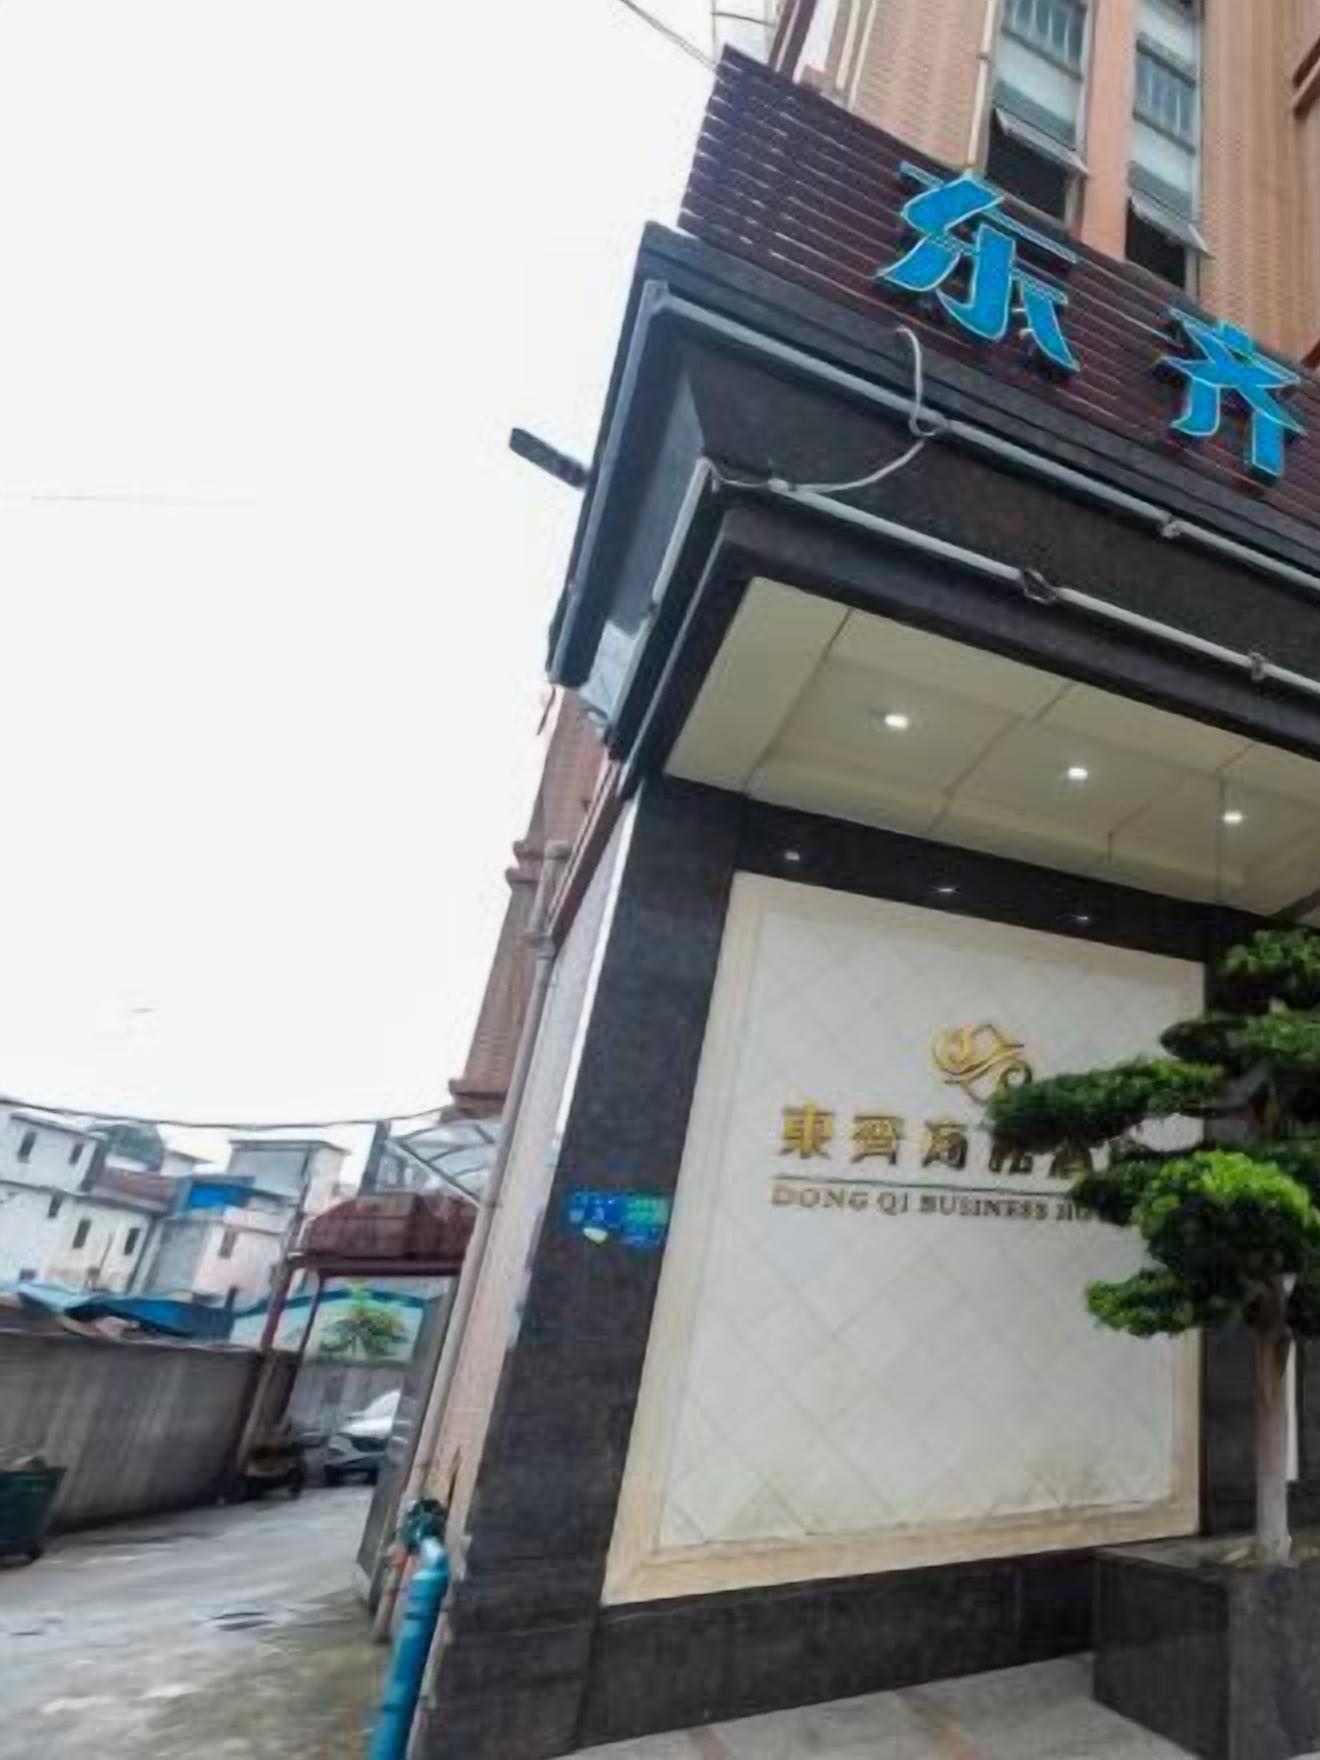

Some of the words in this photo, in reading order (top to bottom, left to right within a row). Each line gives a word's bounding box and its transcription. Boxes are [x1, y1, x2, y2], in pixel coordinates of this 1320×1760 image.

[771, 1183, 869, 1212] DONG
[876, 1191, 909, 1216] QI
[919, 1194, 1049, 1220] BUSINESS
